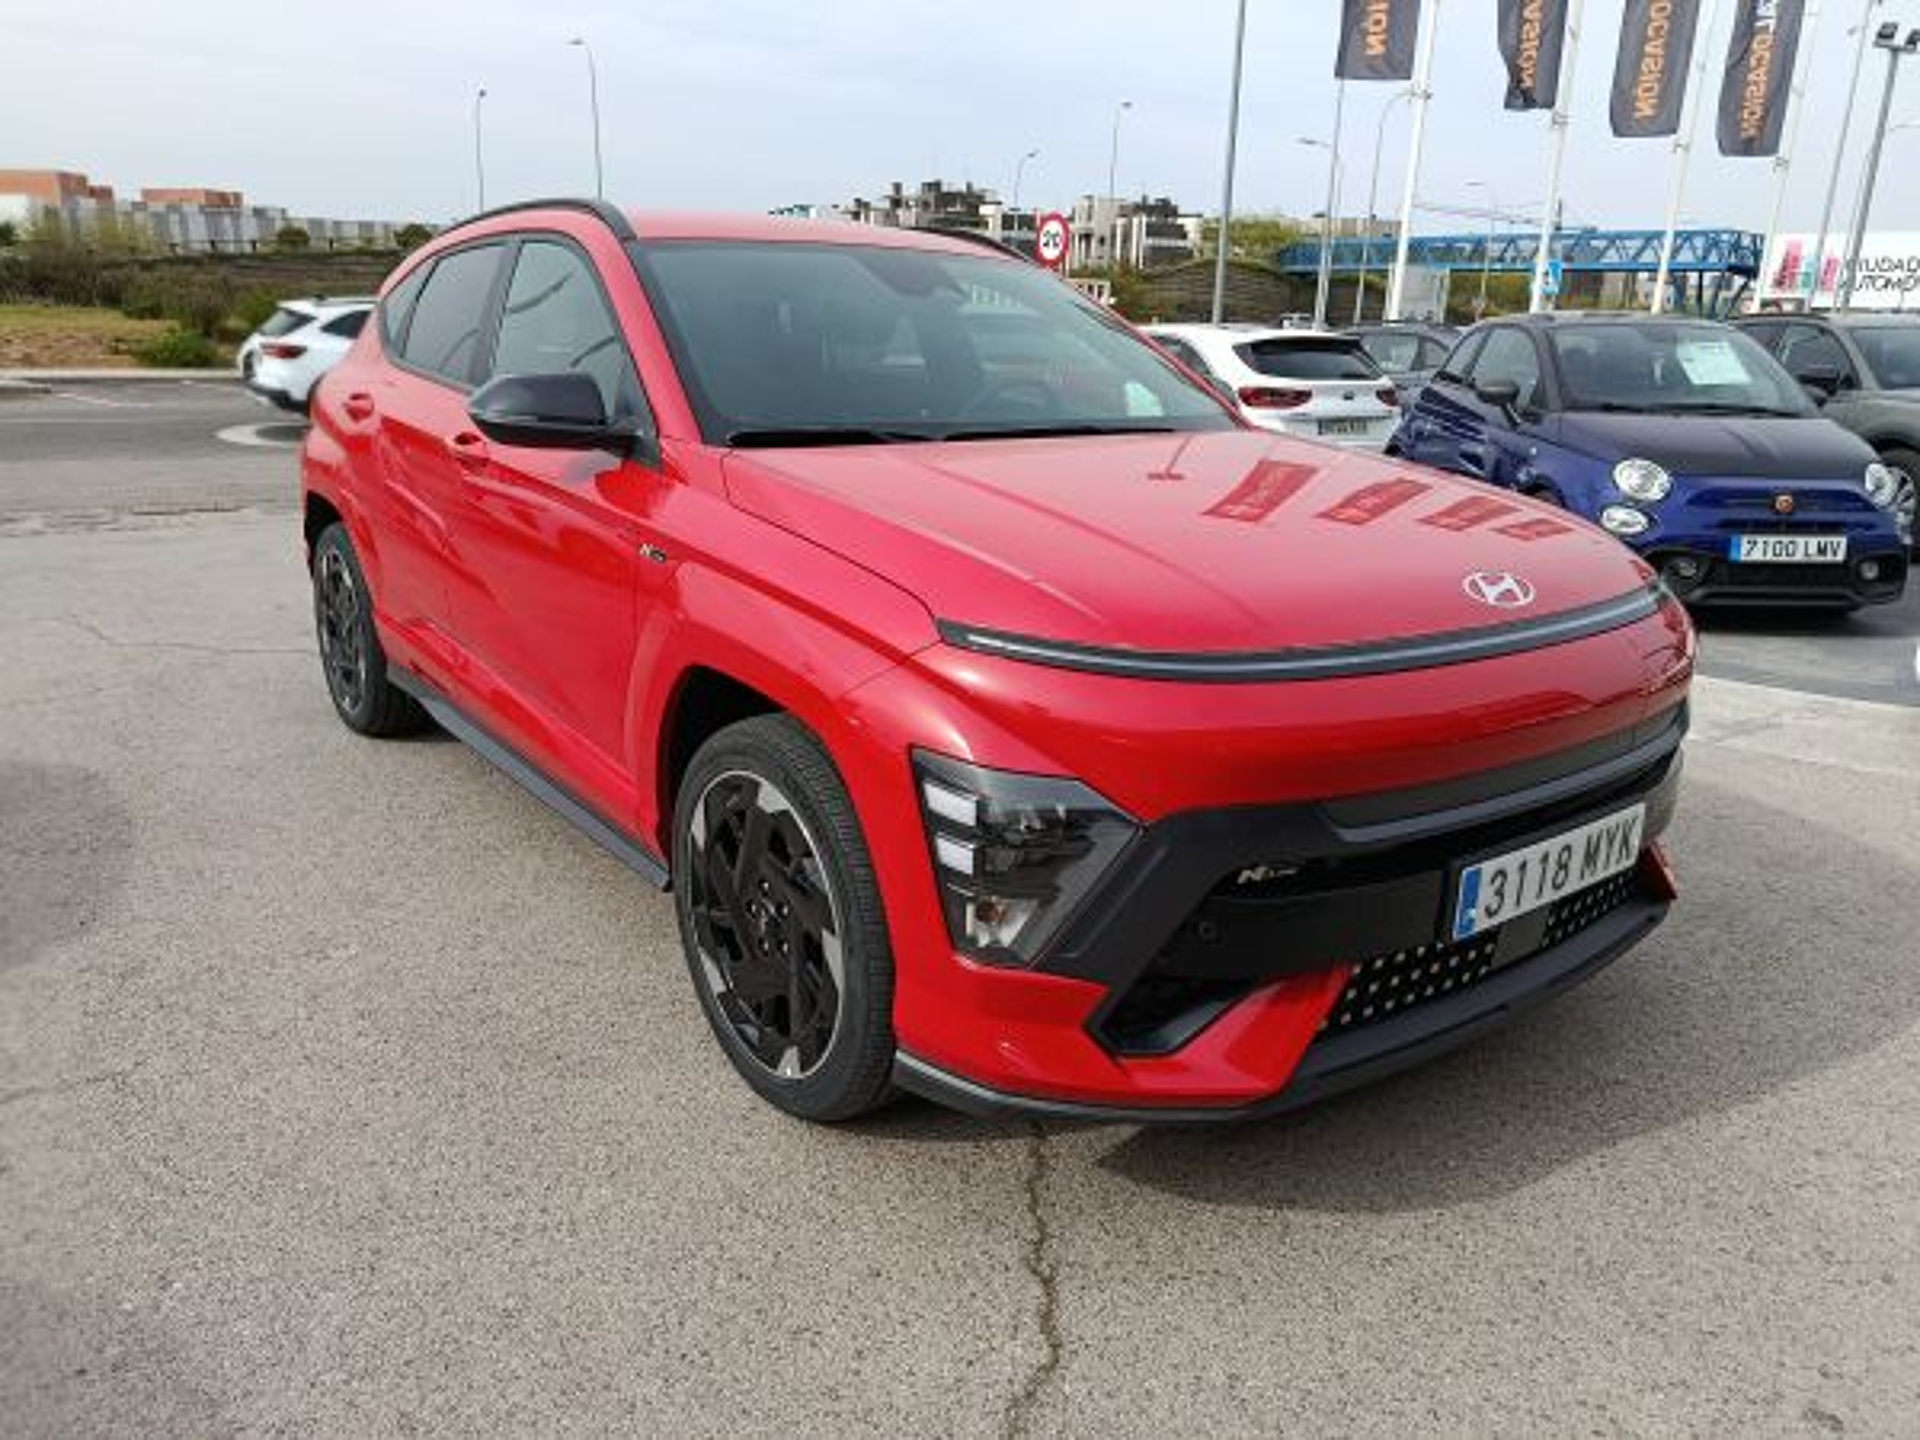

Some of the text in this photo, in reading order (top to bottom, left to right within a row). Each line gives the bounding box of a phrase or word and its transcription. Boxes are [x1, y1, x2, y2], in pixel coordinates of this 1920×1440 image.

[1743, 539, 1842, 558] 7100 LMV
[1484, 815, 1639, 919] 3118 MYK
